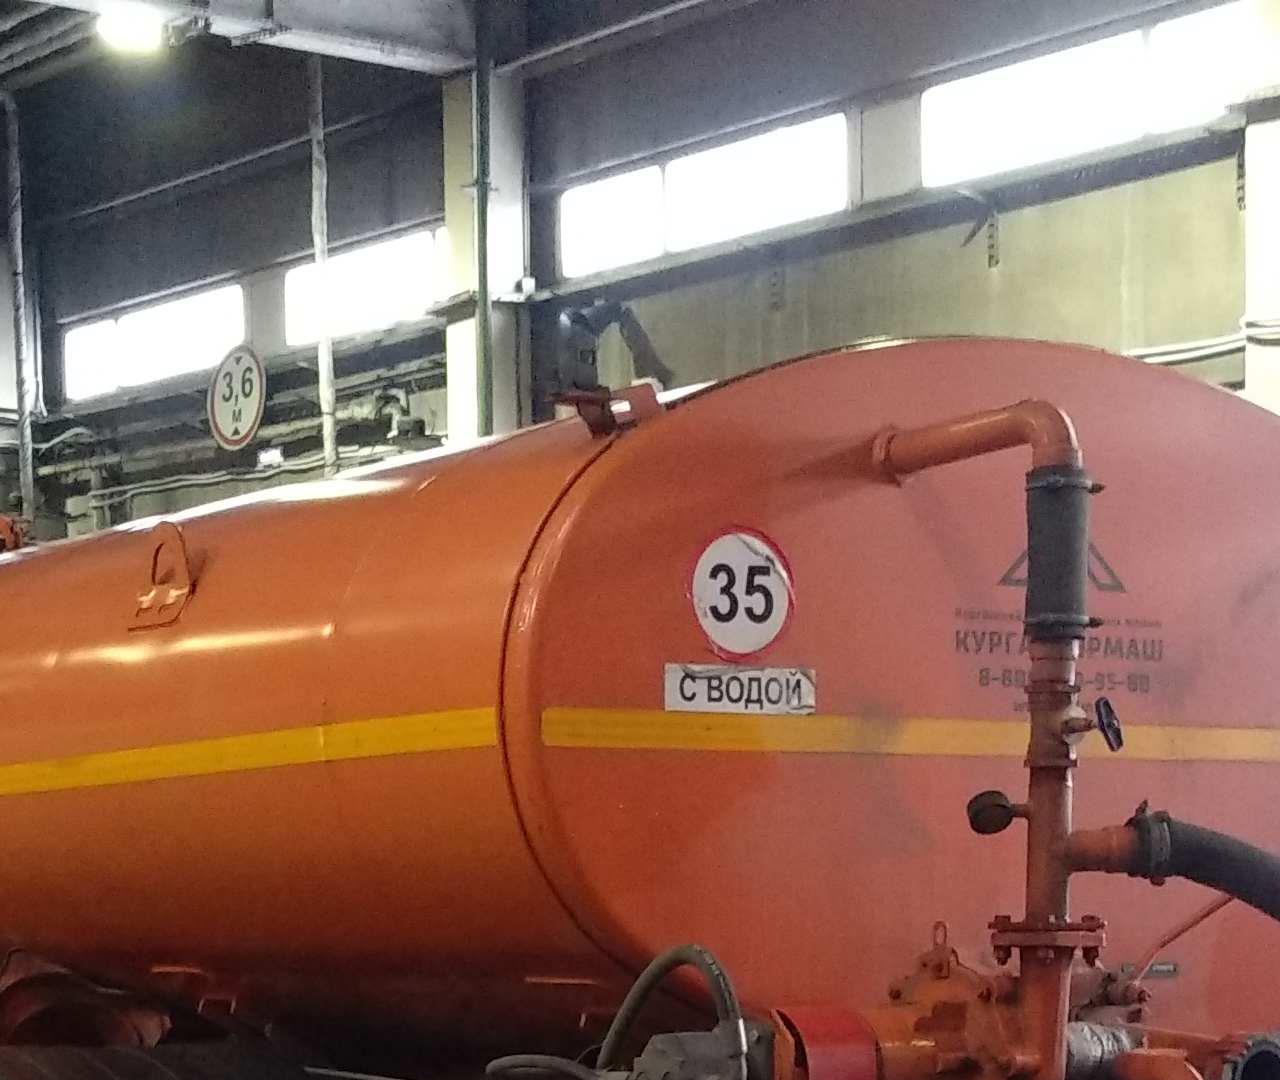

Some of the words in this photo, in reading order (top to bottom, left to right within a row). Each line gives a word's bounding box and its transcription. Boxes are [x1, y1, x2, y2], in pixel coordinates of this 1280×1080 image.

[221, 366, 254, 406] 3,6
[708, 563, 774, 624] 35
[678, 672, 698, 702] С
[706, 670, 803, 710] ВОДОЙ
